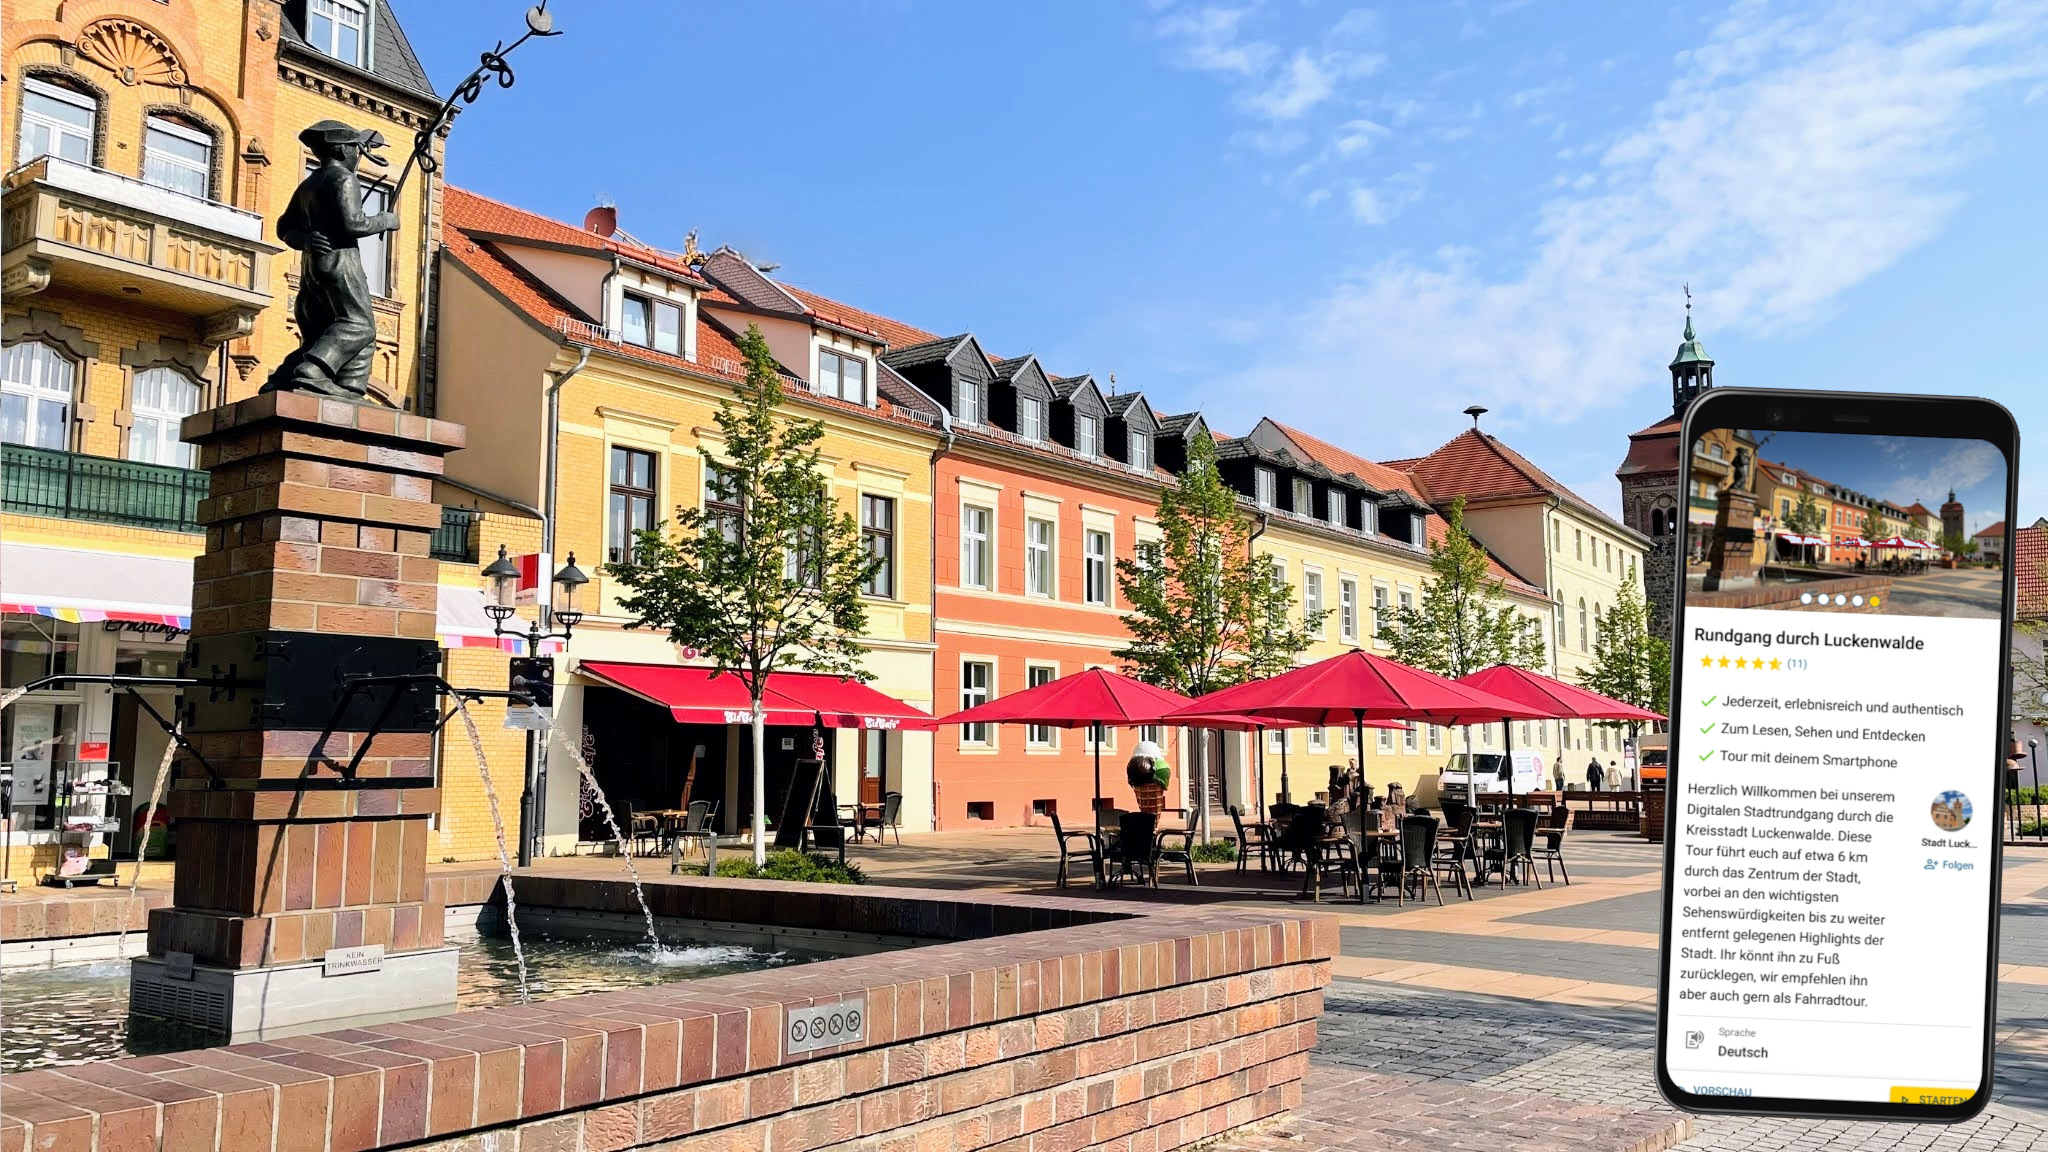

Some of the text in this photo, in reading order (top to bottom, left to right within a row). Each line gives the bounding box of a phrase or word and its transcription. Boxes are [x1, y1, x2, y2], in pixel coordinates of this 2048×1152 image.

[1695, 628, 1924, 650] Rundgang durch Luckenwalde
[1788, 659, 1807, 670] (11)
[1723, 696, 1963, 715] Jederzeit, erlebnisreich und authentisch
[1722, 723, 1925, 741] Zum Lesen, Sehen und Entdecken
[1721, 751, 1897, 768] Tour mit deinem Smartphone
[1689, 784, 1894, 802] Herzlich Willkommen bei unserem
[1688, 804, 1893, 823] Digitalen Stadtrundgang durch die
[1687, 825, 1871, 842] Kreisstadt Luckenwalde. Diese
[1922, 838, 1977, 848] Stadt Luck...
[1686, 845, 1867, 862] Tour führt euch auf etwa 6 km
[1943, 861, 1973, 870] Folgen
[1685, 865, 1860, 884] durch das Zentrum der Stadt,
[1684, 887, 1838, 904] vorbei an den wichtigsten
[1683, 906, 1885, 925] Sehenswürdigkeiten bis zu weiter
[1682, 928, 1884, 946] entfernt gelegenen Highlights der
[327, 957, 383, 970] TRINKWASSER
[1682, 948, 1839, 964] Stadt. Ihr könnt ihn zu Fuß
[1681, 969, 1867, 985] zurücklegen, wir empfehlen ihn
[1681, 989, 1867, 1006] aber auch gern als Fahrradtour.
[1720, 1028, 1755, 1037] Sprache
[1718, 1046, 1768, 1058] Deutsch
[1693, 1085, 1752, 1097] VORSCHAU
